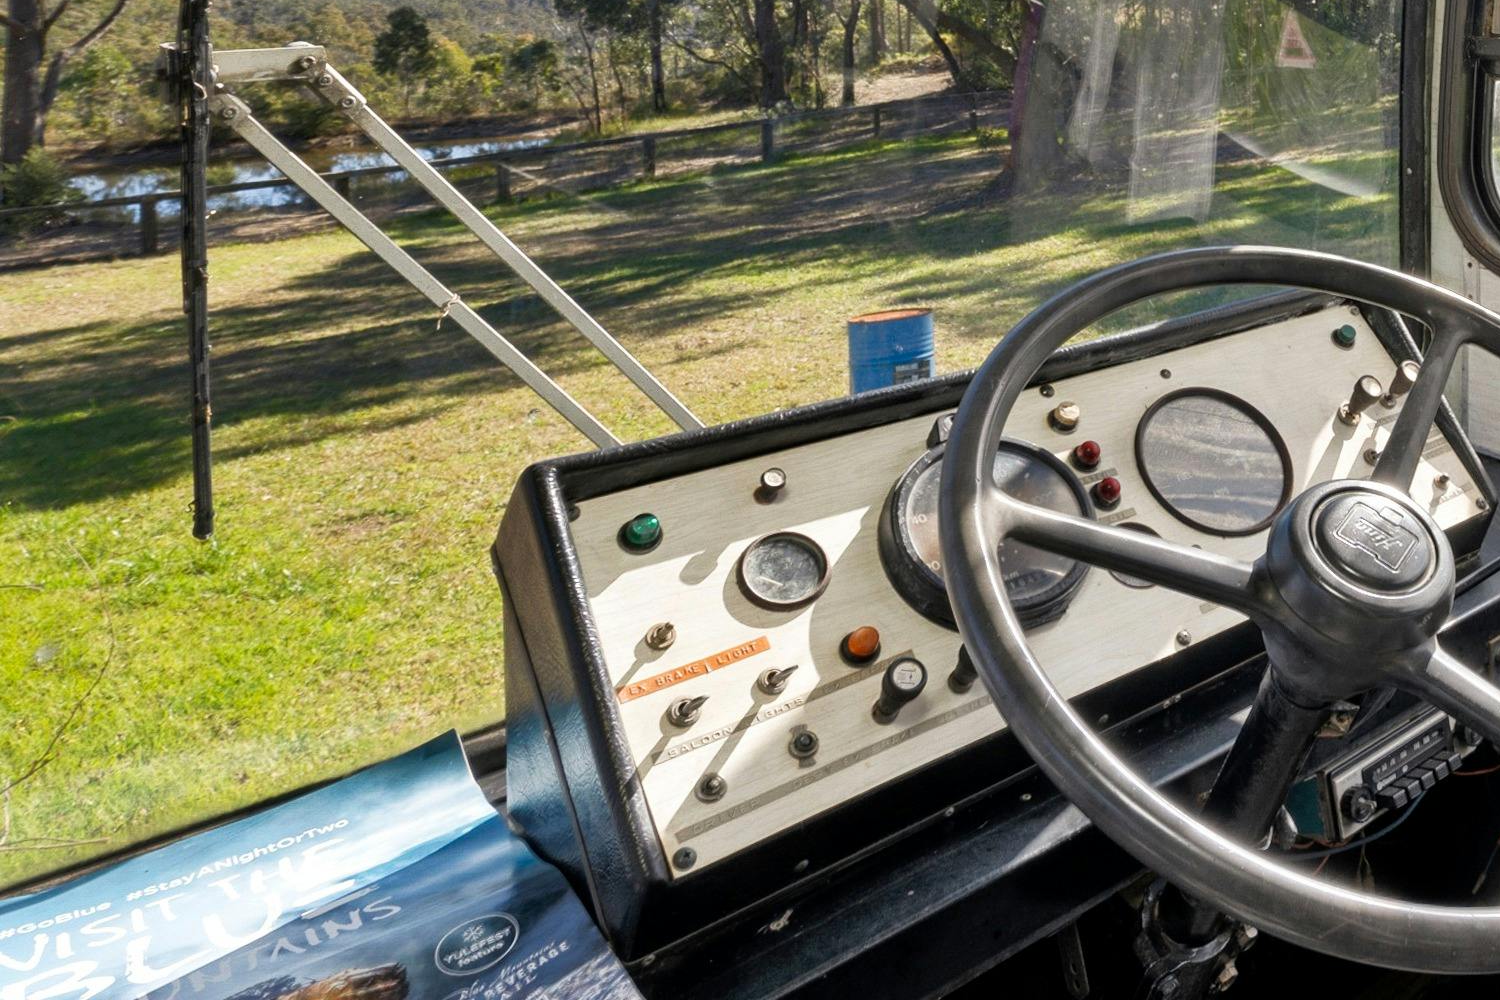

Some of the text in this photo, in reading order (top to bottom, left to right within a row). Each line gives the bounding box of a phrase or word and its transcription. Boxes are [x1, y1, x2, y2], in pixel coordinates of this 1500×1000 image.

[628, 640, 759, 696] EX BRAKE LIGHT
[666, 695, 806, 758] SALOON IGHTS
[0, 838, 345, 971] VISIT THE
[0, 902, 112, 939] #GoBlue
[443, 925, 512, 964] YULEFEST
[457, 940, 505, 968] feature
